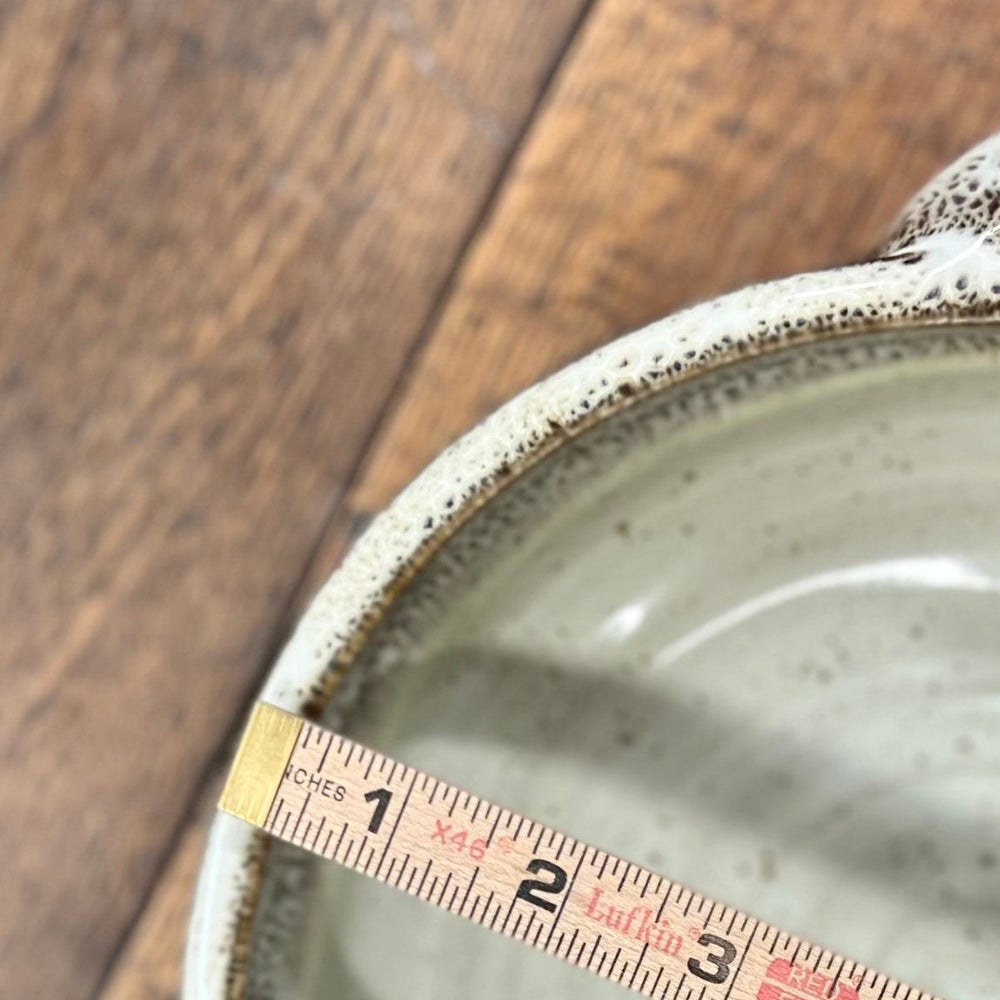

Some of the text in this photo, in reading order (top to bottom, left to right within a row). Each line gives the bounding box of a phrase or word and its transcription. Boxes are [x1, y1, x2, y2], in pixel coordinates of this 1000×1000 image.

[364, 788, 393, 834] 1
[515, 858, 569, 914] 2
[585, 887, 684, 957] Lufkin
[687, 934, 738, 984] 3
